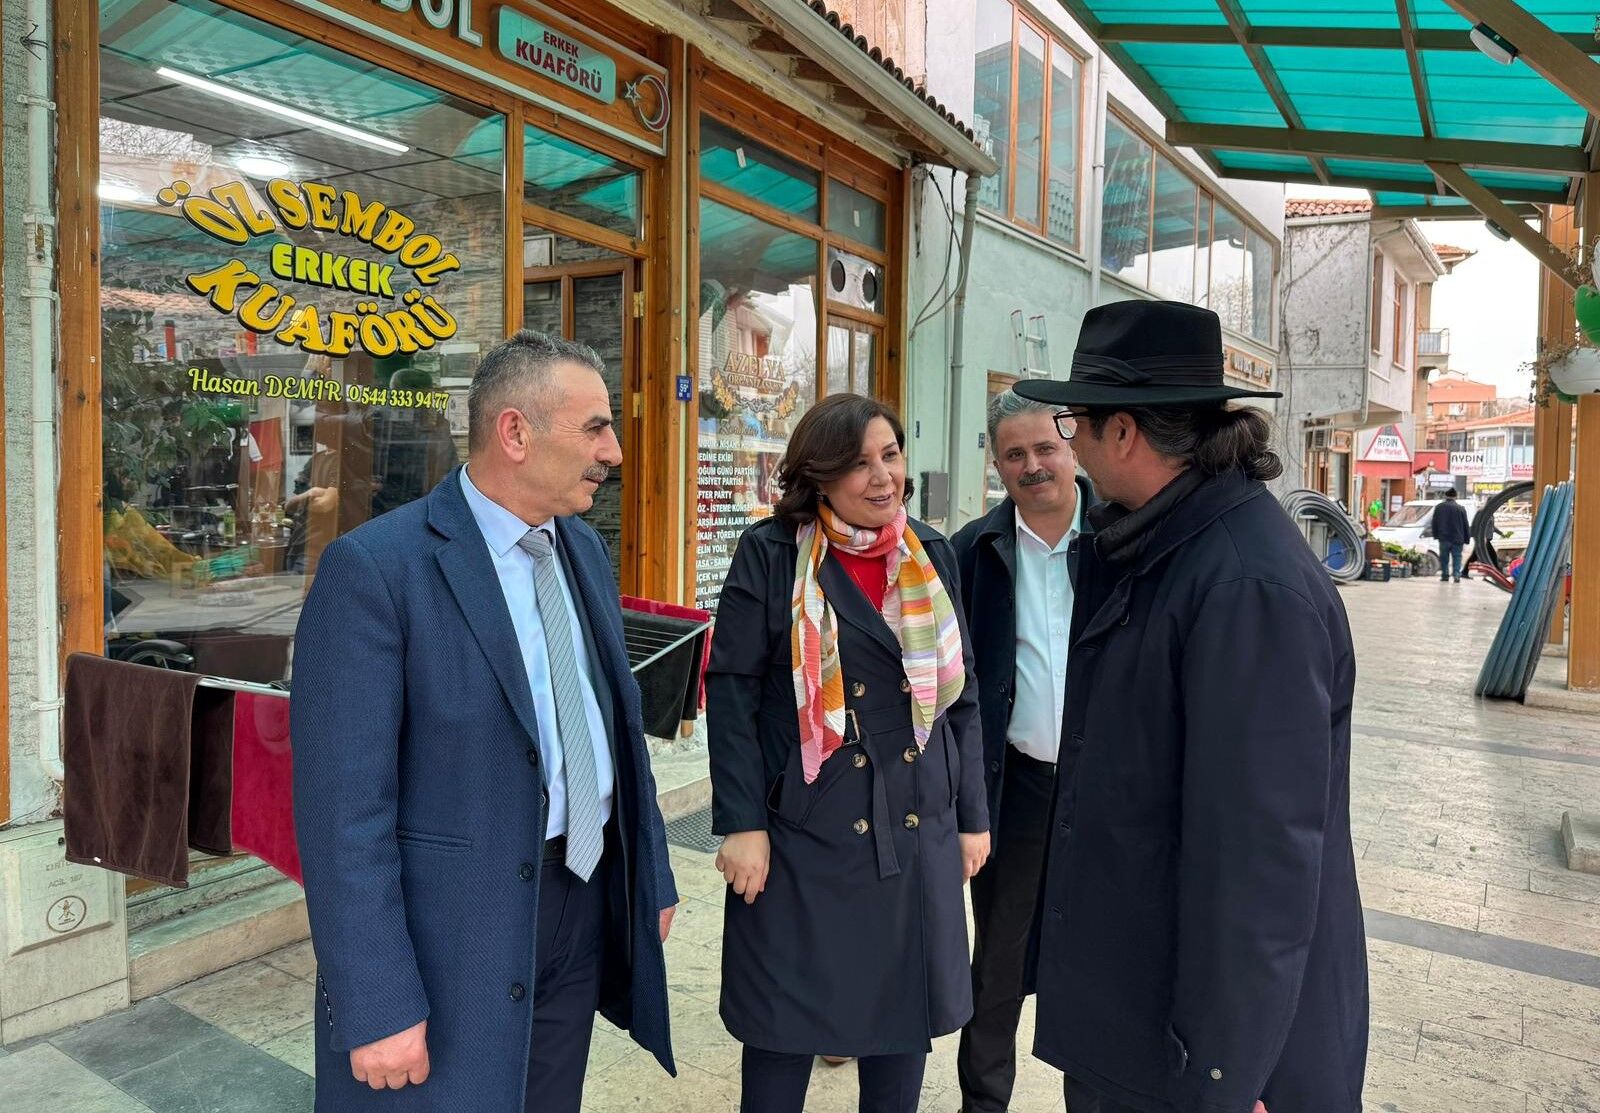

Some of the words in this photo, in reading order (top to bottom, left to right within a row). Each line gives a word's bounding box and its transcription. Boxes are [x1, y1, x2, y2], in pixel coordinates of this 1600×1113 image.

[543, 30, 579, 58] ERKEK
[516, 38, 602, 94] KUAFÖRÜ
[157, 180, 276, 245] ÖZ
[267, 178, 461, 285] SEMBOL
[271, 242, 396, 298] ERKEK
[186, 258, 458, 358] KUAFÖRÜ
[188, 368, 260, 396] Hasan
[264, 375, 342, 402] DEMİR
[1377, 437, 1398, 447] AYDIN
[1451, 455, 1484, 463] AYDIN
[697, 491, 713, 499] FTER
[714, 491, 732, 499] PARTY
[697, 503, 706, 512] ÖZ
[697, 544, 711, 554] ELİN
[712, 544, 727, 553] YOLU
[696, 558, 710, 568] ASA
